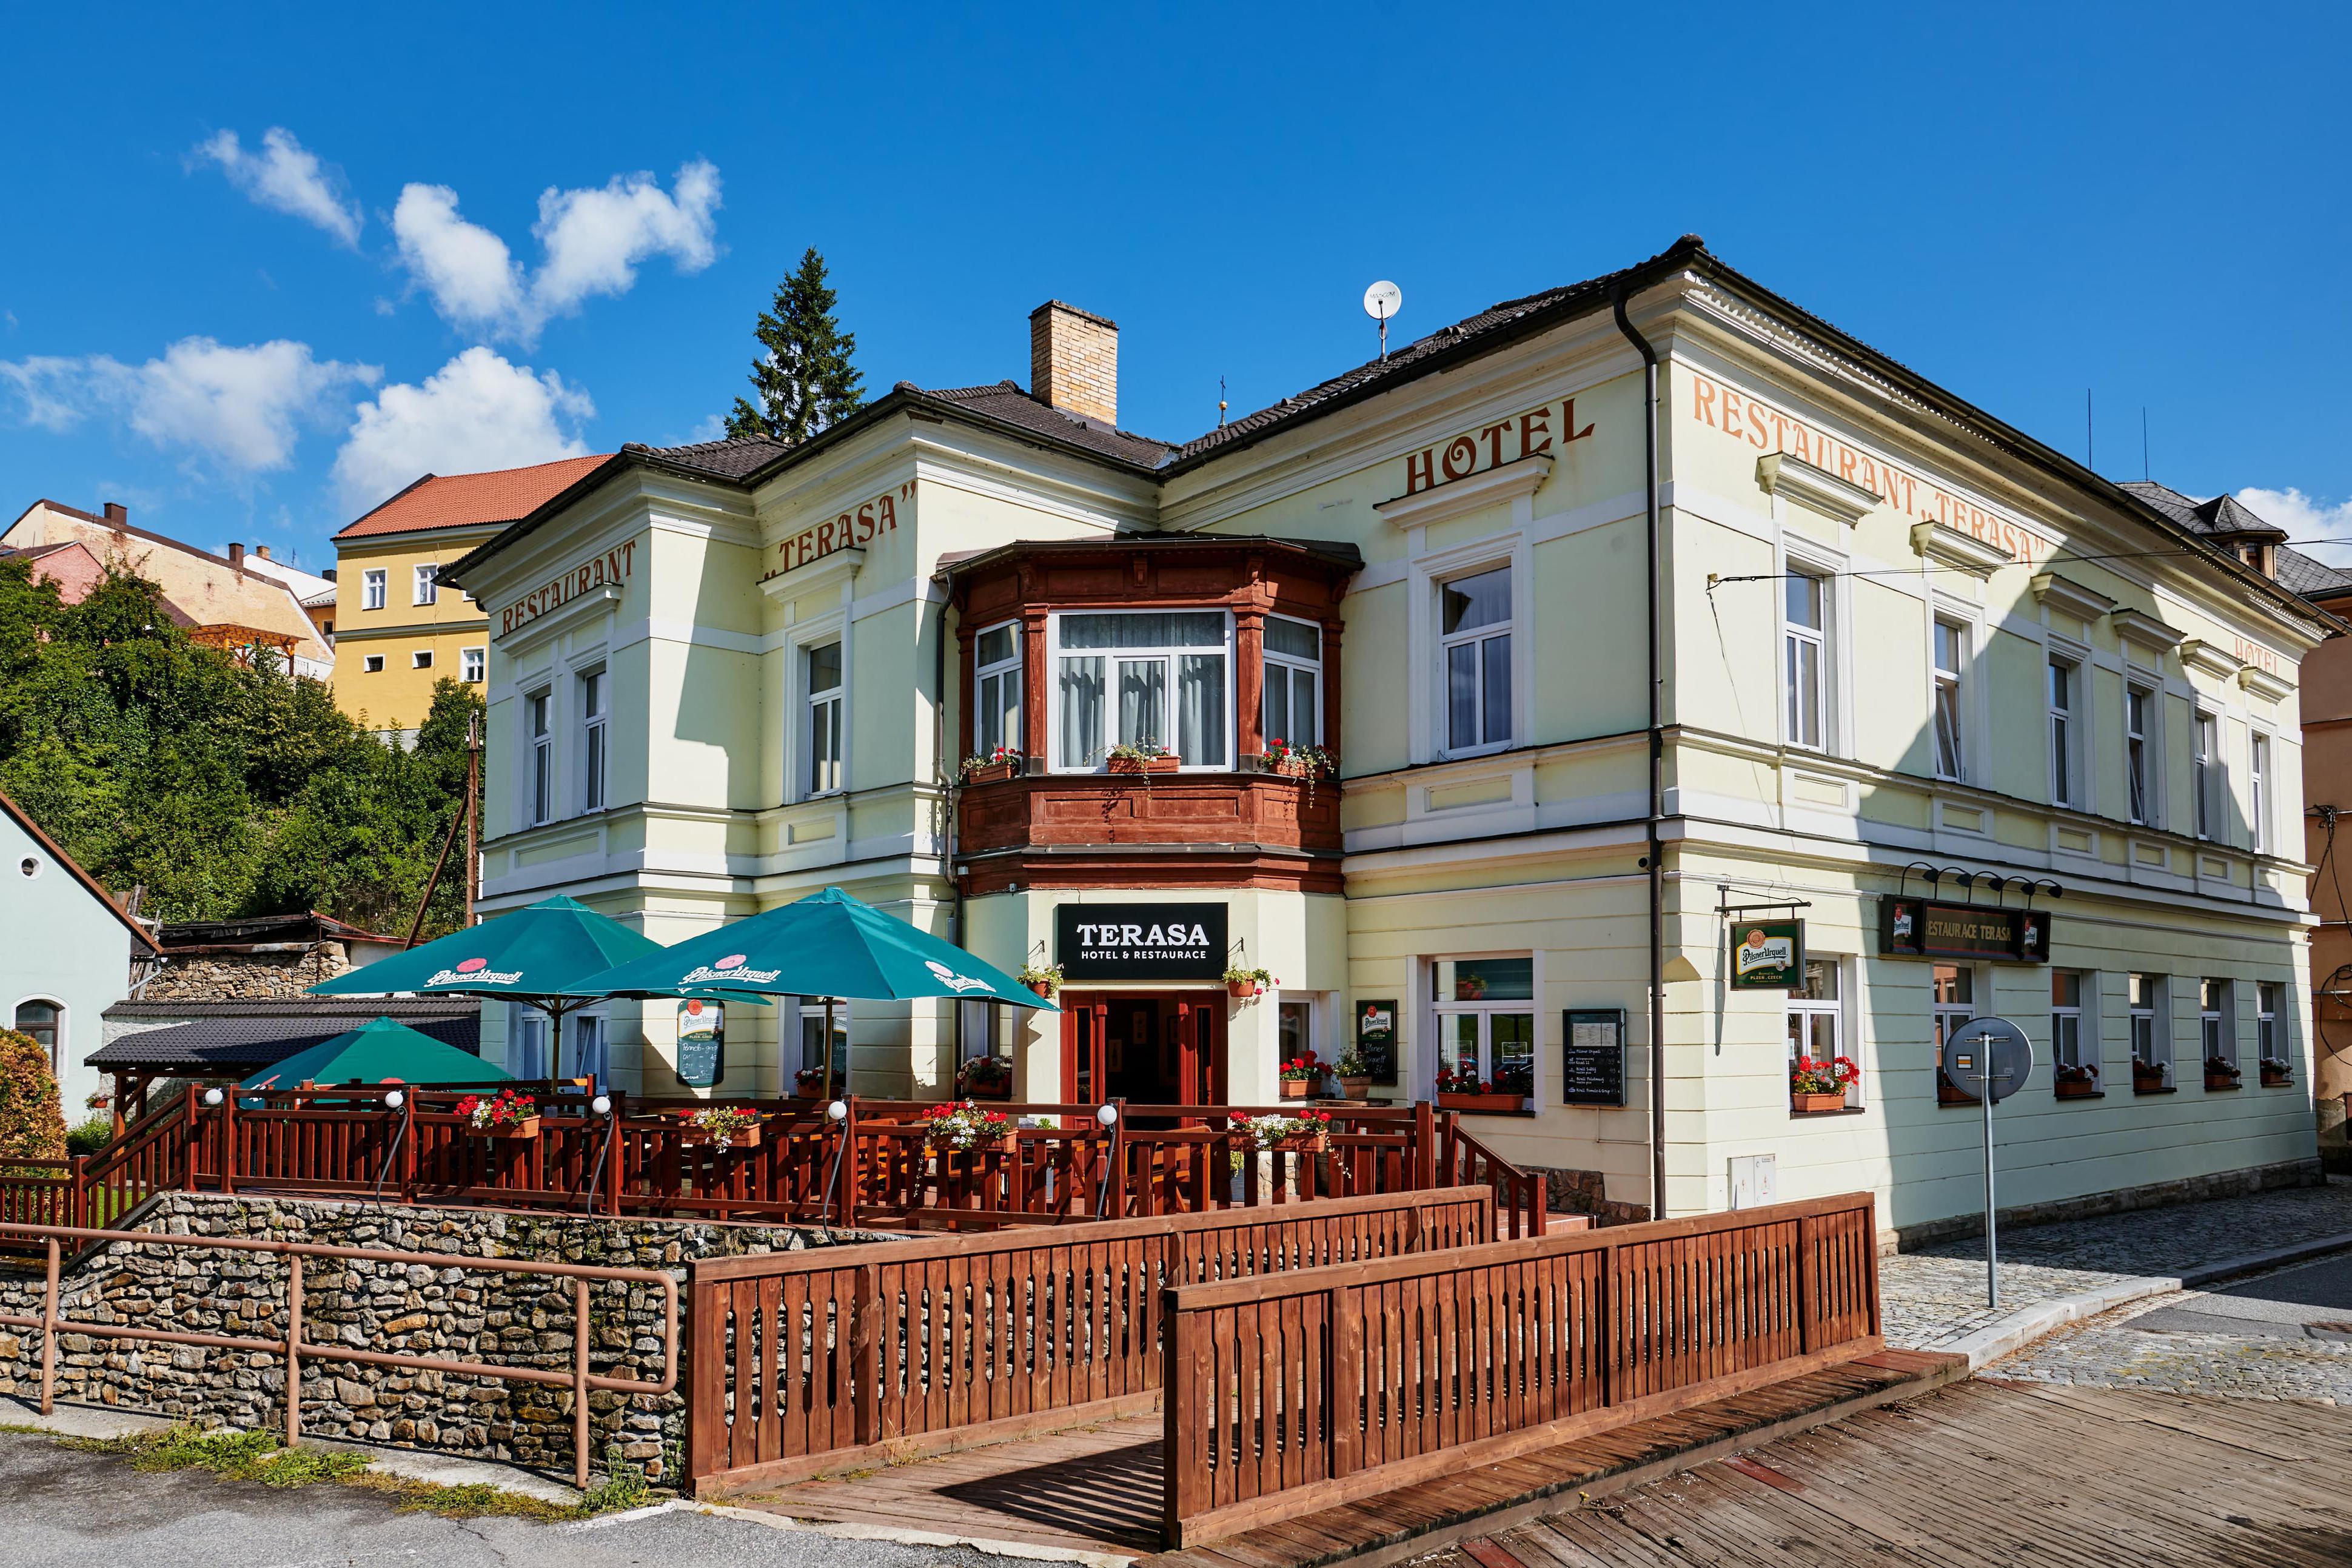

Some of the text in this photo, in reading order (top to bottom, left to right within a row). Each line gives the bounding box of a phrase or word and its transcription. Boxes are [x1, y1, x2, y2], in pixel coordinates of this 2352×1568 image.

[1406, 398, 1596, 495] HOTEL
[1693, 375, 1918, 516] RESTAURANT
[503, 539, 637, 635] RESTAURANT
[1076, 923, 1210, 946] TERASA
[1979, 925, 2012, 942] TERASA
[1081, 950, 1207, 960] HOTEL & RESTAURACE
[1742, 946, 1786, 966] Pilsner Urquell
[423, 968, 524, 988] Pilsner Urquell
[677, 965, 782, 985] Pilsner Urquell
[683, 1015, 703, 1029] Pilsner
[1364, 1017, 1378, 1029] Pilsner
